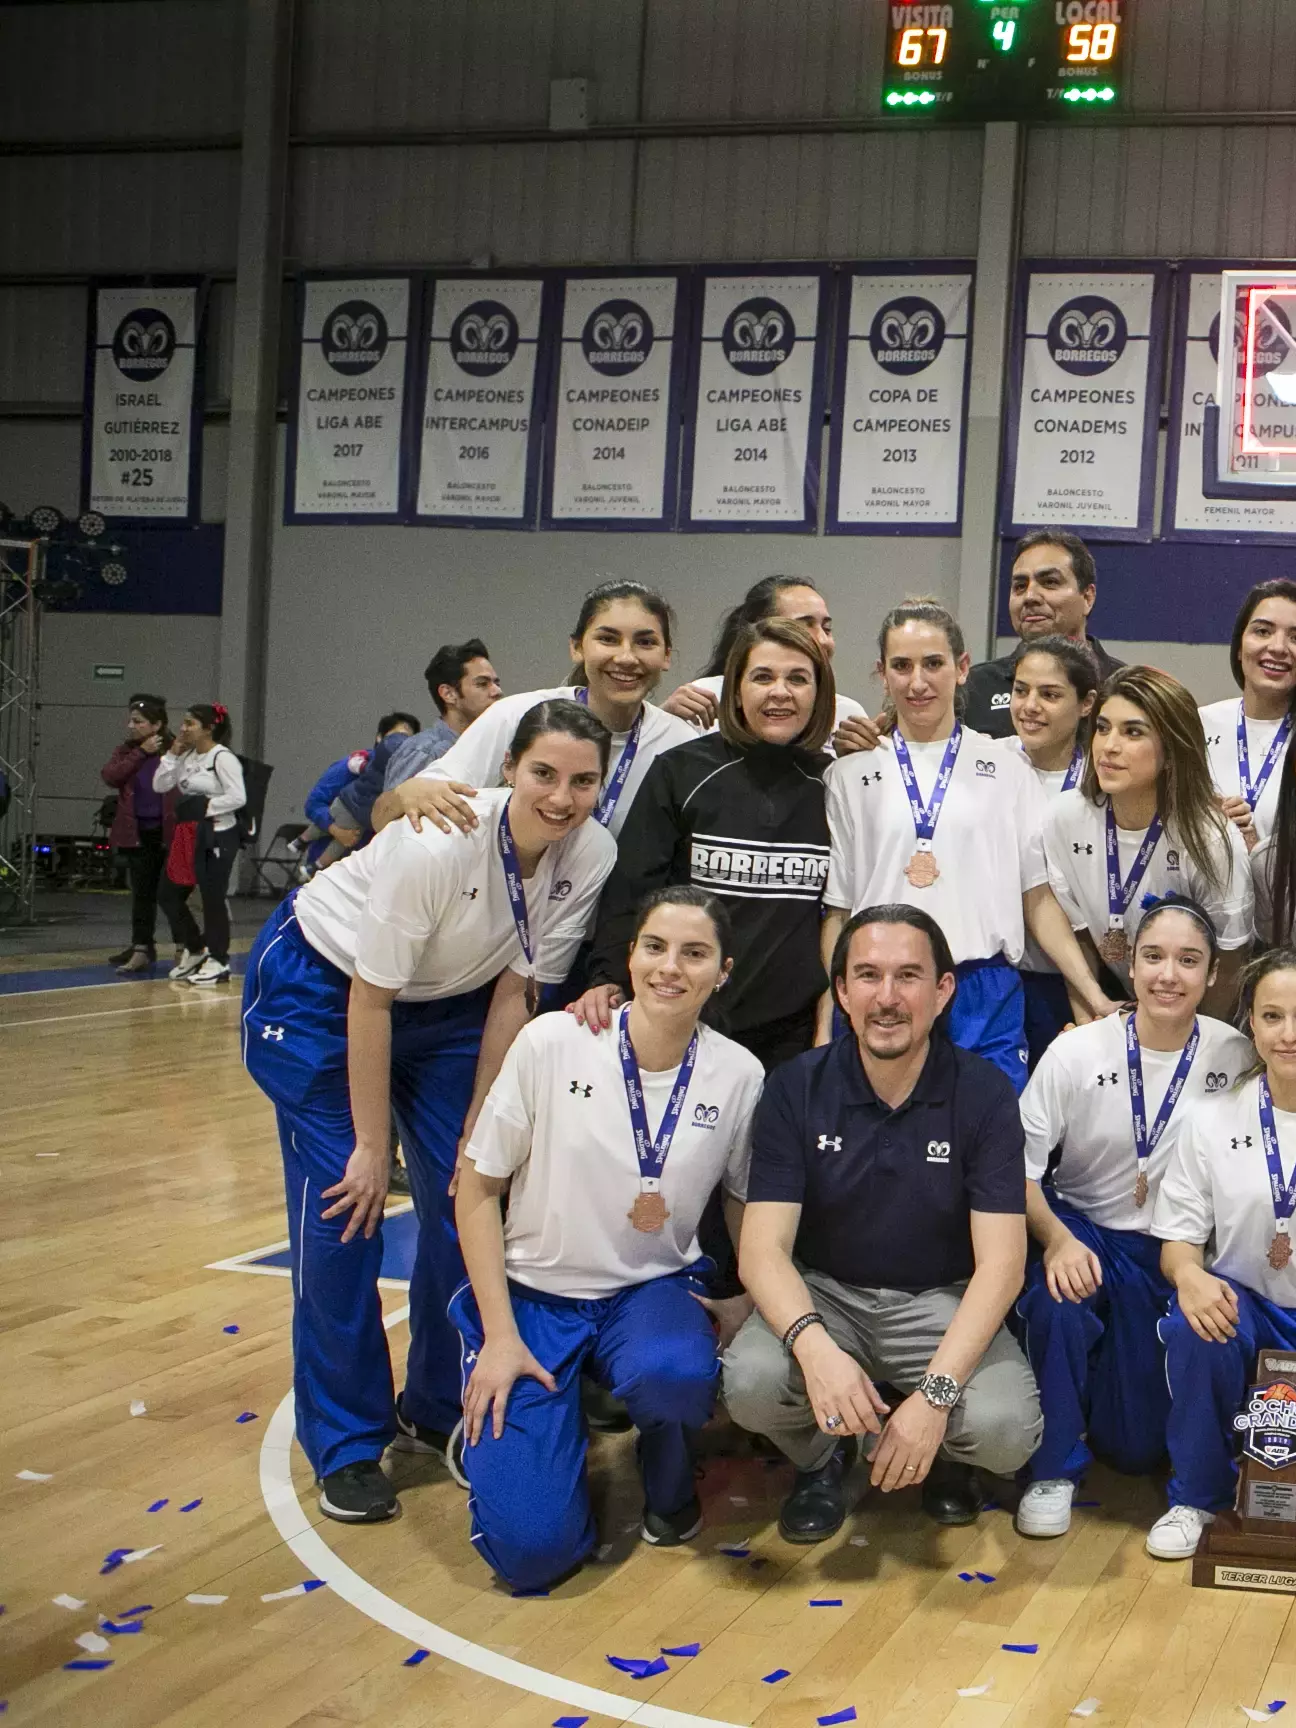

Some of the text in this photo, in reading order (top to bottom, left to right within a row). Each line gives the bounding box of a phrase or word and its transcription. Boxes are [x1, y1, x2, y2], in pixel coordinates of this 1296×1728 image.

[892, 5, 953, 28] VISITA
[990, 7, 1019, 19] PER
[1055, 1, 1121, 24] LOCAL
[992, 20, 1015, 50] 4
[1066, 23, 1117, 61] 58
[898, 28, 947, 65] 67
[904, 71, 943, 81] BONUS
[1058, 67, 1098, 77] BONUS
[589, 351, 644, 363] BORREGOS
[729, 350, 785, 362] BORREGOS
[877, 349, 935, 361] BORREGOS
[1055, 349, 1117, 362] BORREGOS
[115, 394, 161, 406] ISRAEL
[307, 388, 395, 402] CAMPEONES
[434, 388, 525, 403] CAMPEONES
[566, 389, 660, 403] CAMPEONES
[707, 389, 802, 402] CAMPEONES
[869, 389, 938, 403] COPA DE
[1030, 389, 1135, 404] CAMPEONES
[104, 419, 180, 434] GUTIÉRREZ
[317, 416, 383, 429] LIGA ABE
[425, 417, 528, 431] INTERCAMPUS
[572, 418, 650, 431] CONADEIP
[717, 418, 787, 432] LIGA ABE
[853, 419, 951, 432] CAMPEONES
[1034, 419, 1127, 434] CONADEMS
[108, 449, 172, 462] 2010-2018
[333, 444, 363, 457] 2017
[459, 446, 490, 459] 2016
[593, 447, 625, 460] 2014
[734, 449, 767, 461] 2014
[883, 449, 917, 463] 2013
[1060, 450, 1095, 464] 2012
[121, 469, 153, 486] #25
[723, 485, 776, 493] BALONCESTO
[1047, 489, 1103, 498] BALONCESTO
[1037, 501, 1112, 511] VARONIL JUVENIL
[1204, 506, 1240, 515] FEMENIL
[691, 847, 829, 887] BORREGOS
[620, 1030, 630, 1060] SPALDING
[1130, 1068, 1139, 1096] SPALDING
[627, 1079, 639, 1110] SPALDING
[671, 1086, 686, 1115] SPALDING
[636, 1129, 648, 1159] SPALDING
[1263, 1127, 1274, 1156] SPALDING
[655, 1134, 671, 1164] SPALDING
[1271, 1174, 1282, 1202] SPALDING
[1221, 1571, 1267, 1584] TERCER
